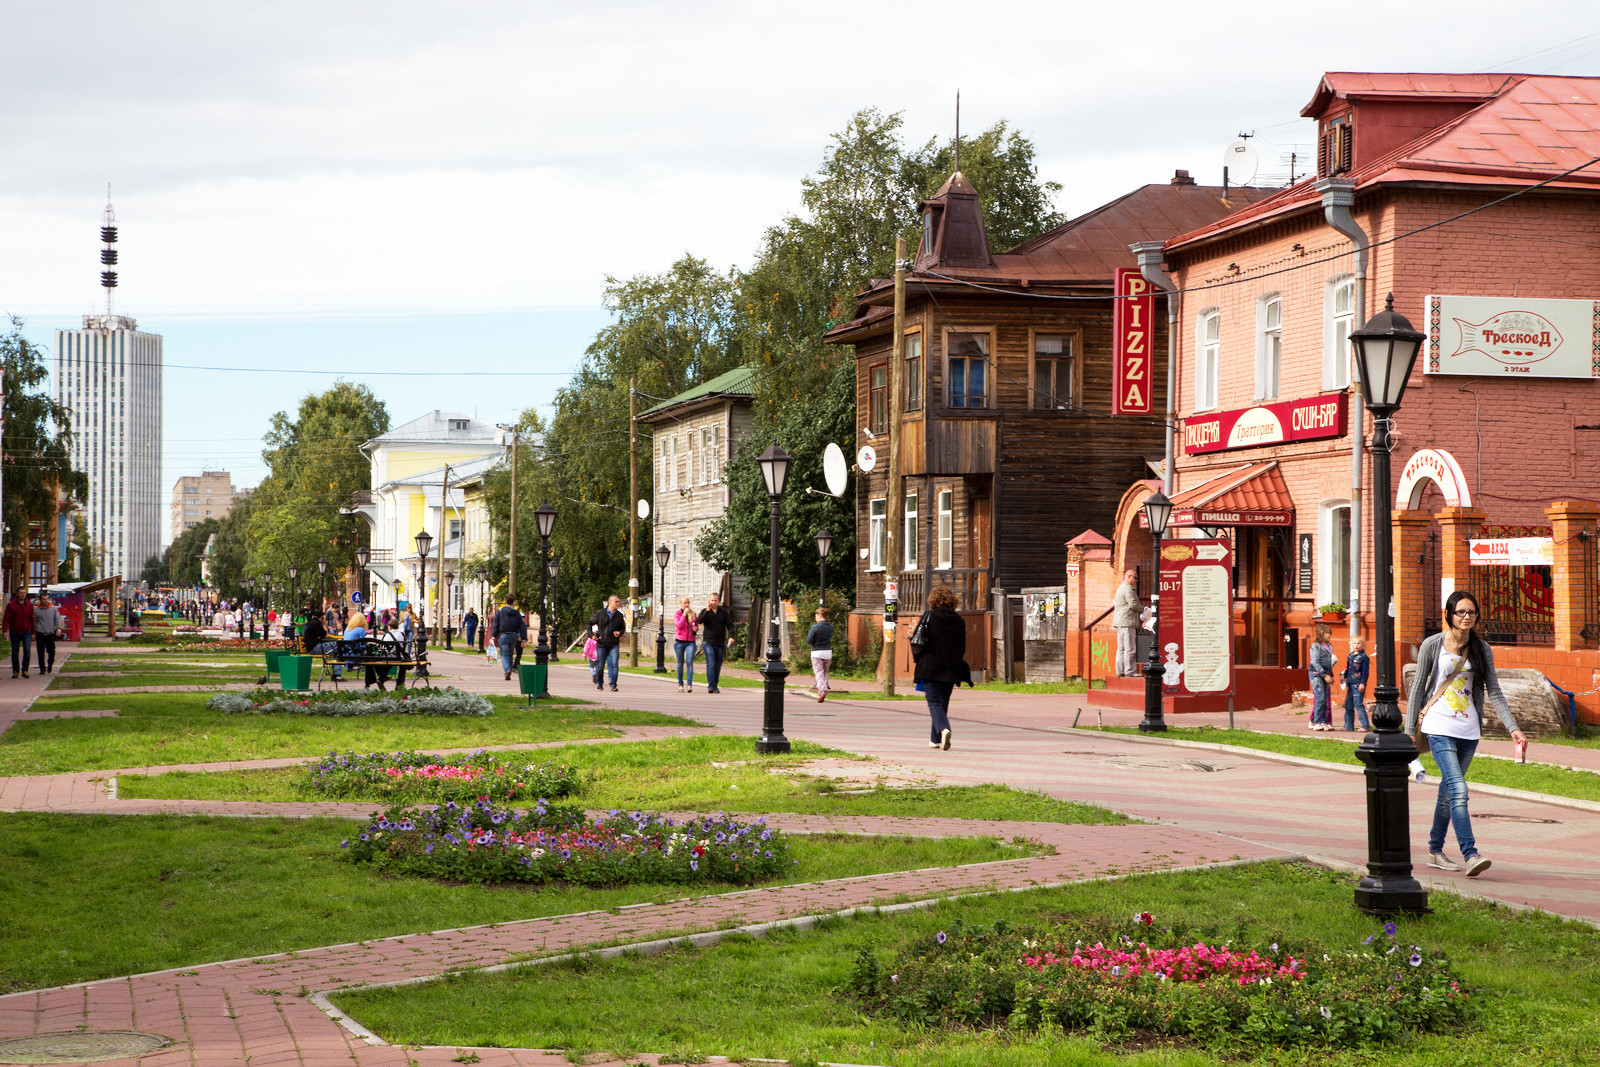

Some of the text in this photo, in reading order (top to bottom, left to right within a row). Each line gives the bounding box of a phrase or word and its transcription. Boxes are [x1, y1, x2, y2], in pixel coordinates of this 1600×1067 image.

[1124, 278, 1146, 407] PIZZA
[1292, 403, 1337, 431] СУШИ-БАР
[1186, 421, 1220, 448] ПИЦЦЕРИЯ
[1236, 422, 1274, 441] Траттория
[1490, 542, 1510, 556] ВХОД
[1159, 581, 1181, 591] 10-17
